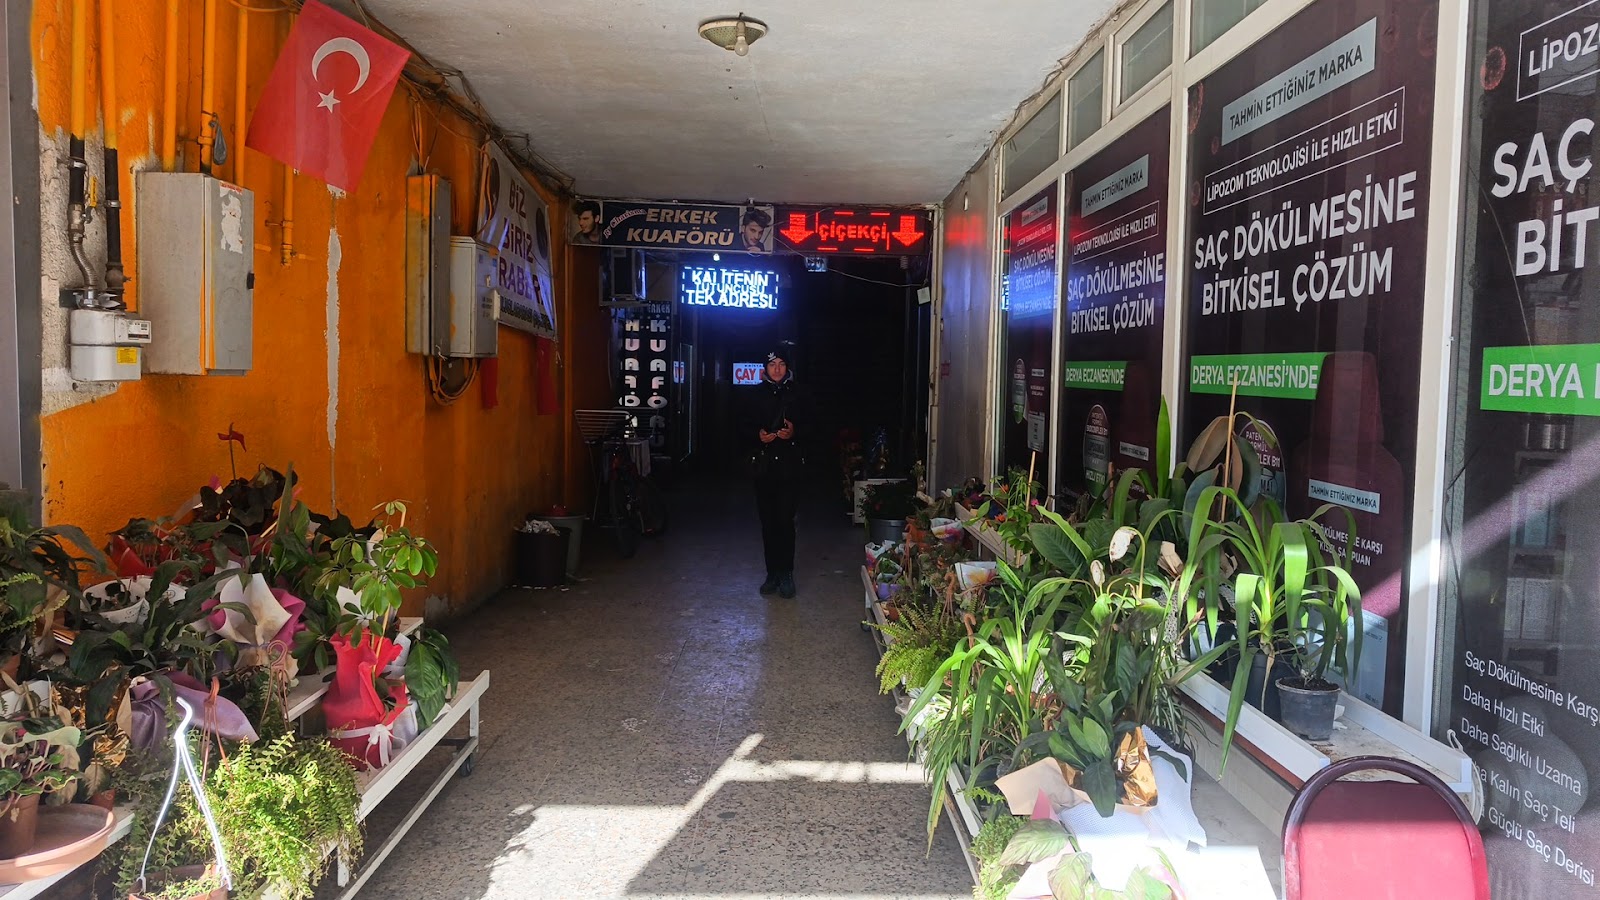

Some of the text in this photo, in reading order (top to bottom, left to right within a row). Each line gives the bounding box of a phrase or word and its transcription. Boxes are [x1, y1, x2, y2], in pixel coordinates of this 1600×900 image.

[1528, 22, 1600, 77] LİPOZ
[1229, 45, 1364, 131] TAHMİN ETTİĞİNİZ MARKA
[1206, 102, 1399, 203] LİPOZOM TEKNOLOJİSİ İLE HIZLI ETKİ
[1491, 118, 1595, 197] SAÇ
[626, 226, 735, 246] KUAFÖRÜ
[646, 208, 719, 225] ERKEK
[818, 220, 888, 243] ÇİÇEKÇİ
[1195, 170, 1417, 271] SAÇ DÖKÜLMESİNE
[1515, 199, 1600, 277] BİT
[1067, 251, 1165, 304] SAÇ DÖKÜLMESİNE
[1202, 241, 1393, 316] BİTKİSEL ÇÖZÜM
[1071, 294, 1156, 335] BİTKİSEL ÇÖZÜM
[735, 367, 757, 384] ÇAY
[1066, 367, 1083, 383] DERYA
[1192, 359, 1319, 389] DERYA ECZANESİ'NDE
[1488, 362, 1585, 399] DERYA
[1310, 484, 1328, 497] TAHMİN
[1356, 494, 1378, 509] MARKA
[1338, 546, 1371, 567] ŞAPUAN
[1361, 539, 1383, 555] KARŞI
[1465, 650, 1486, 677] Saç
[1488, 659, 1564, 707] Dökülmesine
[1463, 684, 1545, 738] Daha Hızlı Etki
[1461, 717, 1582, 796] Daha Sağlıklı Uzama
[1490, 770, 1521, 802] Kalın
[1523, 790, 1549, 822] Saç
[1552, 804, 1576, 834] Teli
[1488, 807, 1523, 841] Güçlü
[1526, 830, 1552, 864] Saç
[1554, 846, 1596, 888] Derisi
